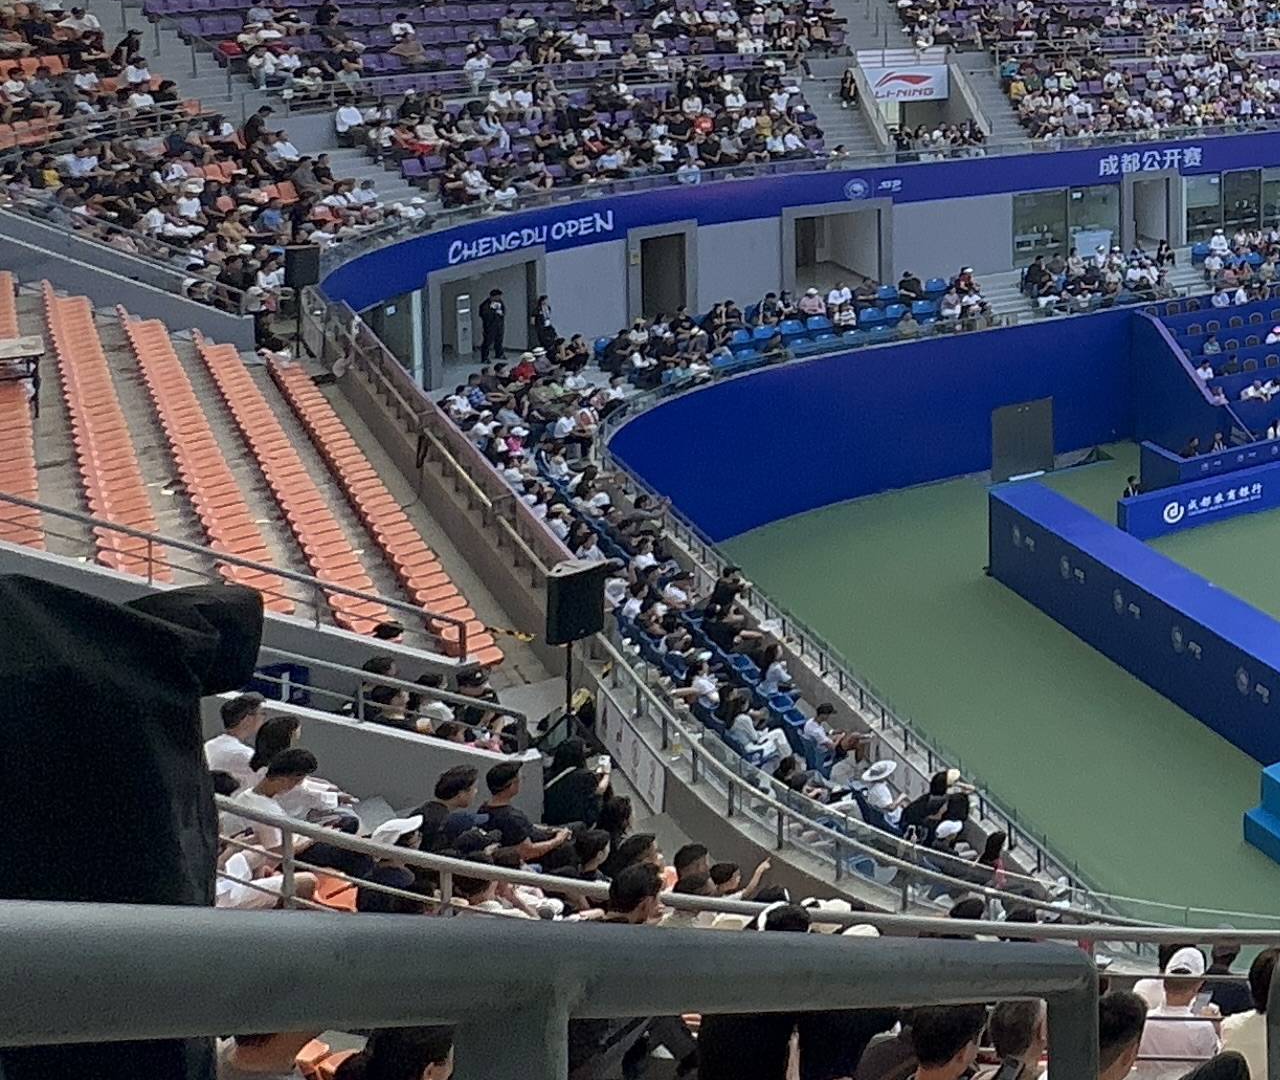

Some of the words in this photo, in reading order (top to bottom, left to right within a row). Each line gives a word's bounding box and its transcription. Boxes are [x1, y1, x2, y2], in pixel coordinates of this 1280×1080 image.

[874, 87, 935, 100] LI-NING
[1098, 146, 1204, 177] 成都公开赛
[448, 225, 548, 265] CHENGDU
[550, 209, 614, 241] OPEN
